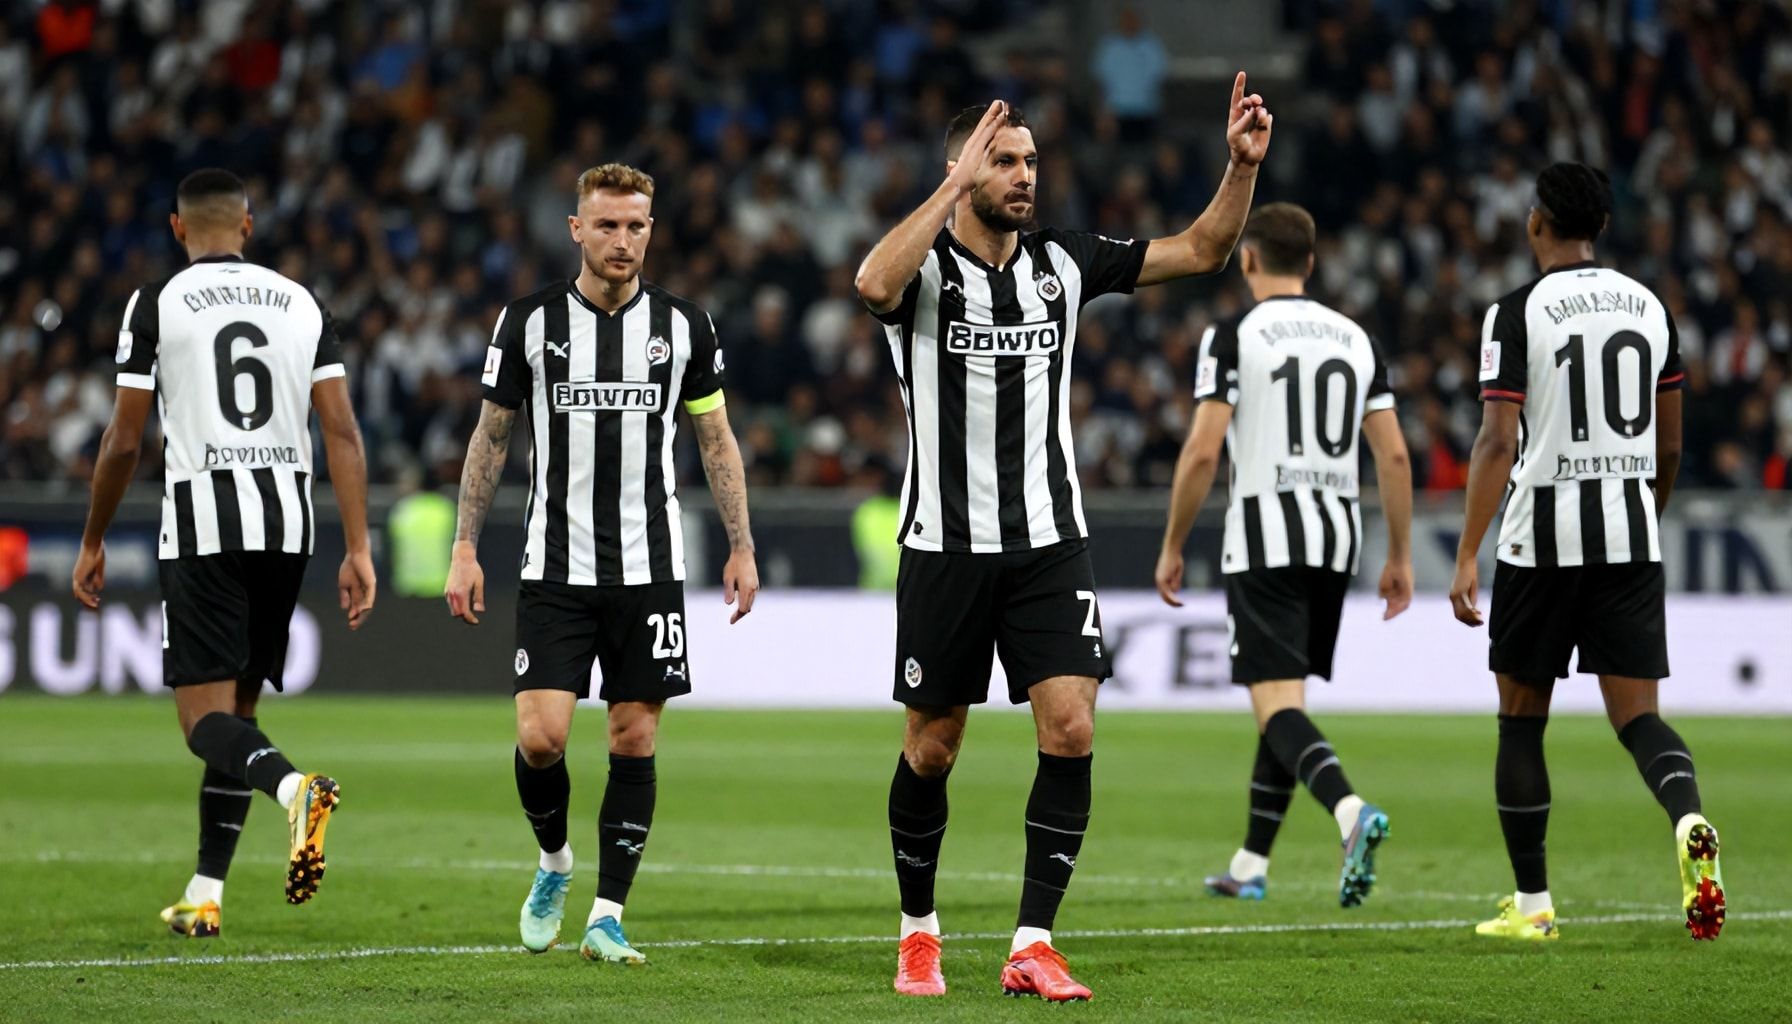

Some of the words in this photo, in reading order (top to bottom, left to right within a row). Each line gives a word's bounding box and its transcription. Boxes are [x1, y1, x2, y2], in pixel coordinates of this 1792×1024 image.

[214, 321, 273, 431] 6
[1271, 356, 1357, 459] 10
[1555, 330, 1652, 442] 10
[647, 612, 684, 659] 26
